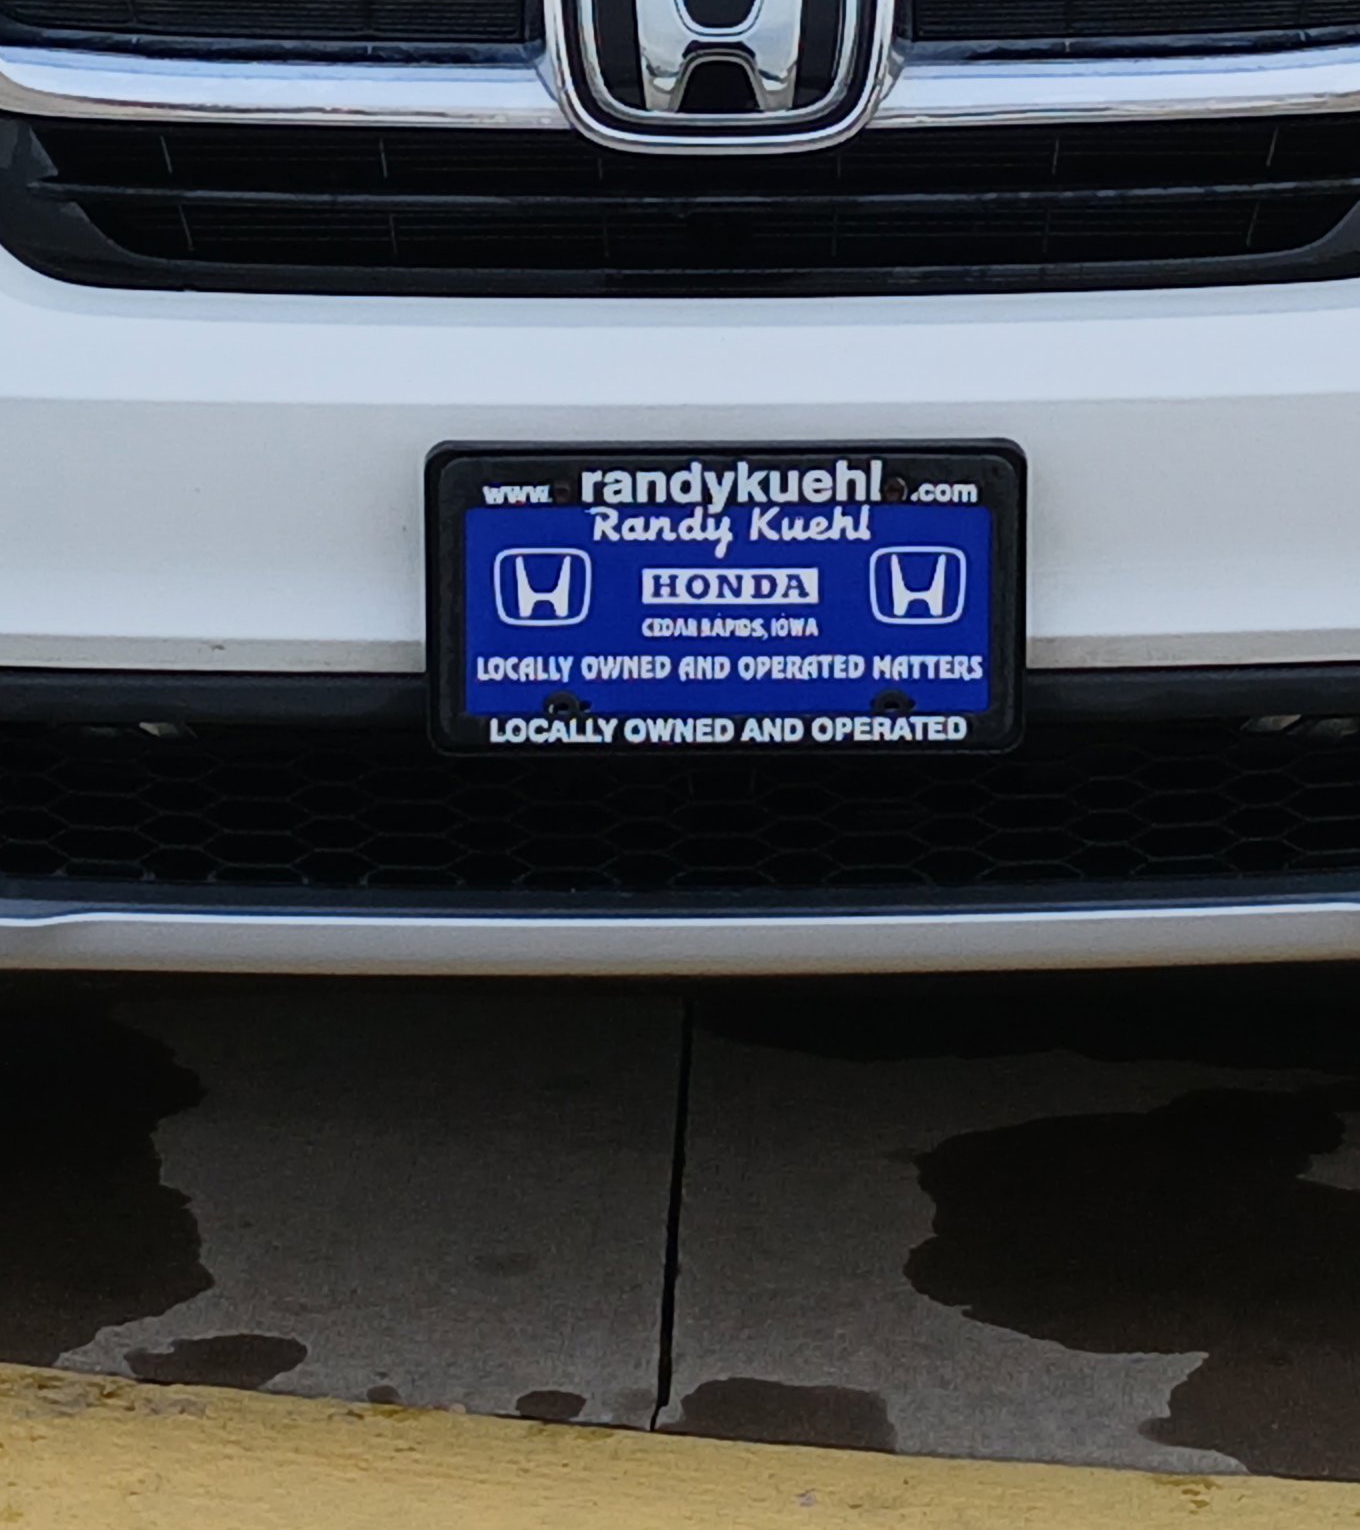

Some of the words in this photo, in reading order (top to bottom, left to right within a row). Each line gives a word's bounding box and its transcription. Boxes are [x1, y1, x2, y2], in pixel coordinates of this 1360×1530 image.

[581, 459, 882, 514] randykuehl
[910, 483, 978, 503] .com
[584, 506, 734, 559] Randy
[749, 504, 871, 541] Kuehl
[650, 573, 810, 601] HONDA
[770, 617, 819, 637] IOWA
[476, 655, 574, 682] LOCALLY
[581, 655, 672, 680] OWNED
[678, 655, 731, 681] AND
[737, 655, 866, 681] OPERATED
[872, 654, 983, 681] MATTERS
[489, 717, 618, 744] LOCALLY
[623, 717, 735, 744] OWNED
[740, 717, 805, 743] AND
[811, 715, 968, 742] OPERATED
